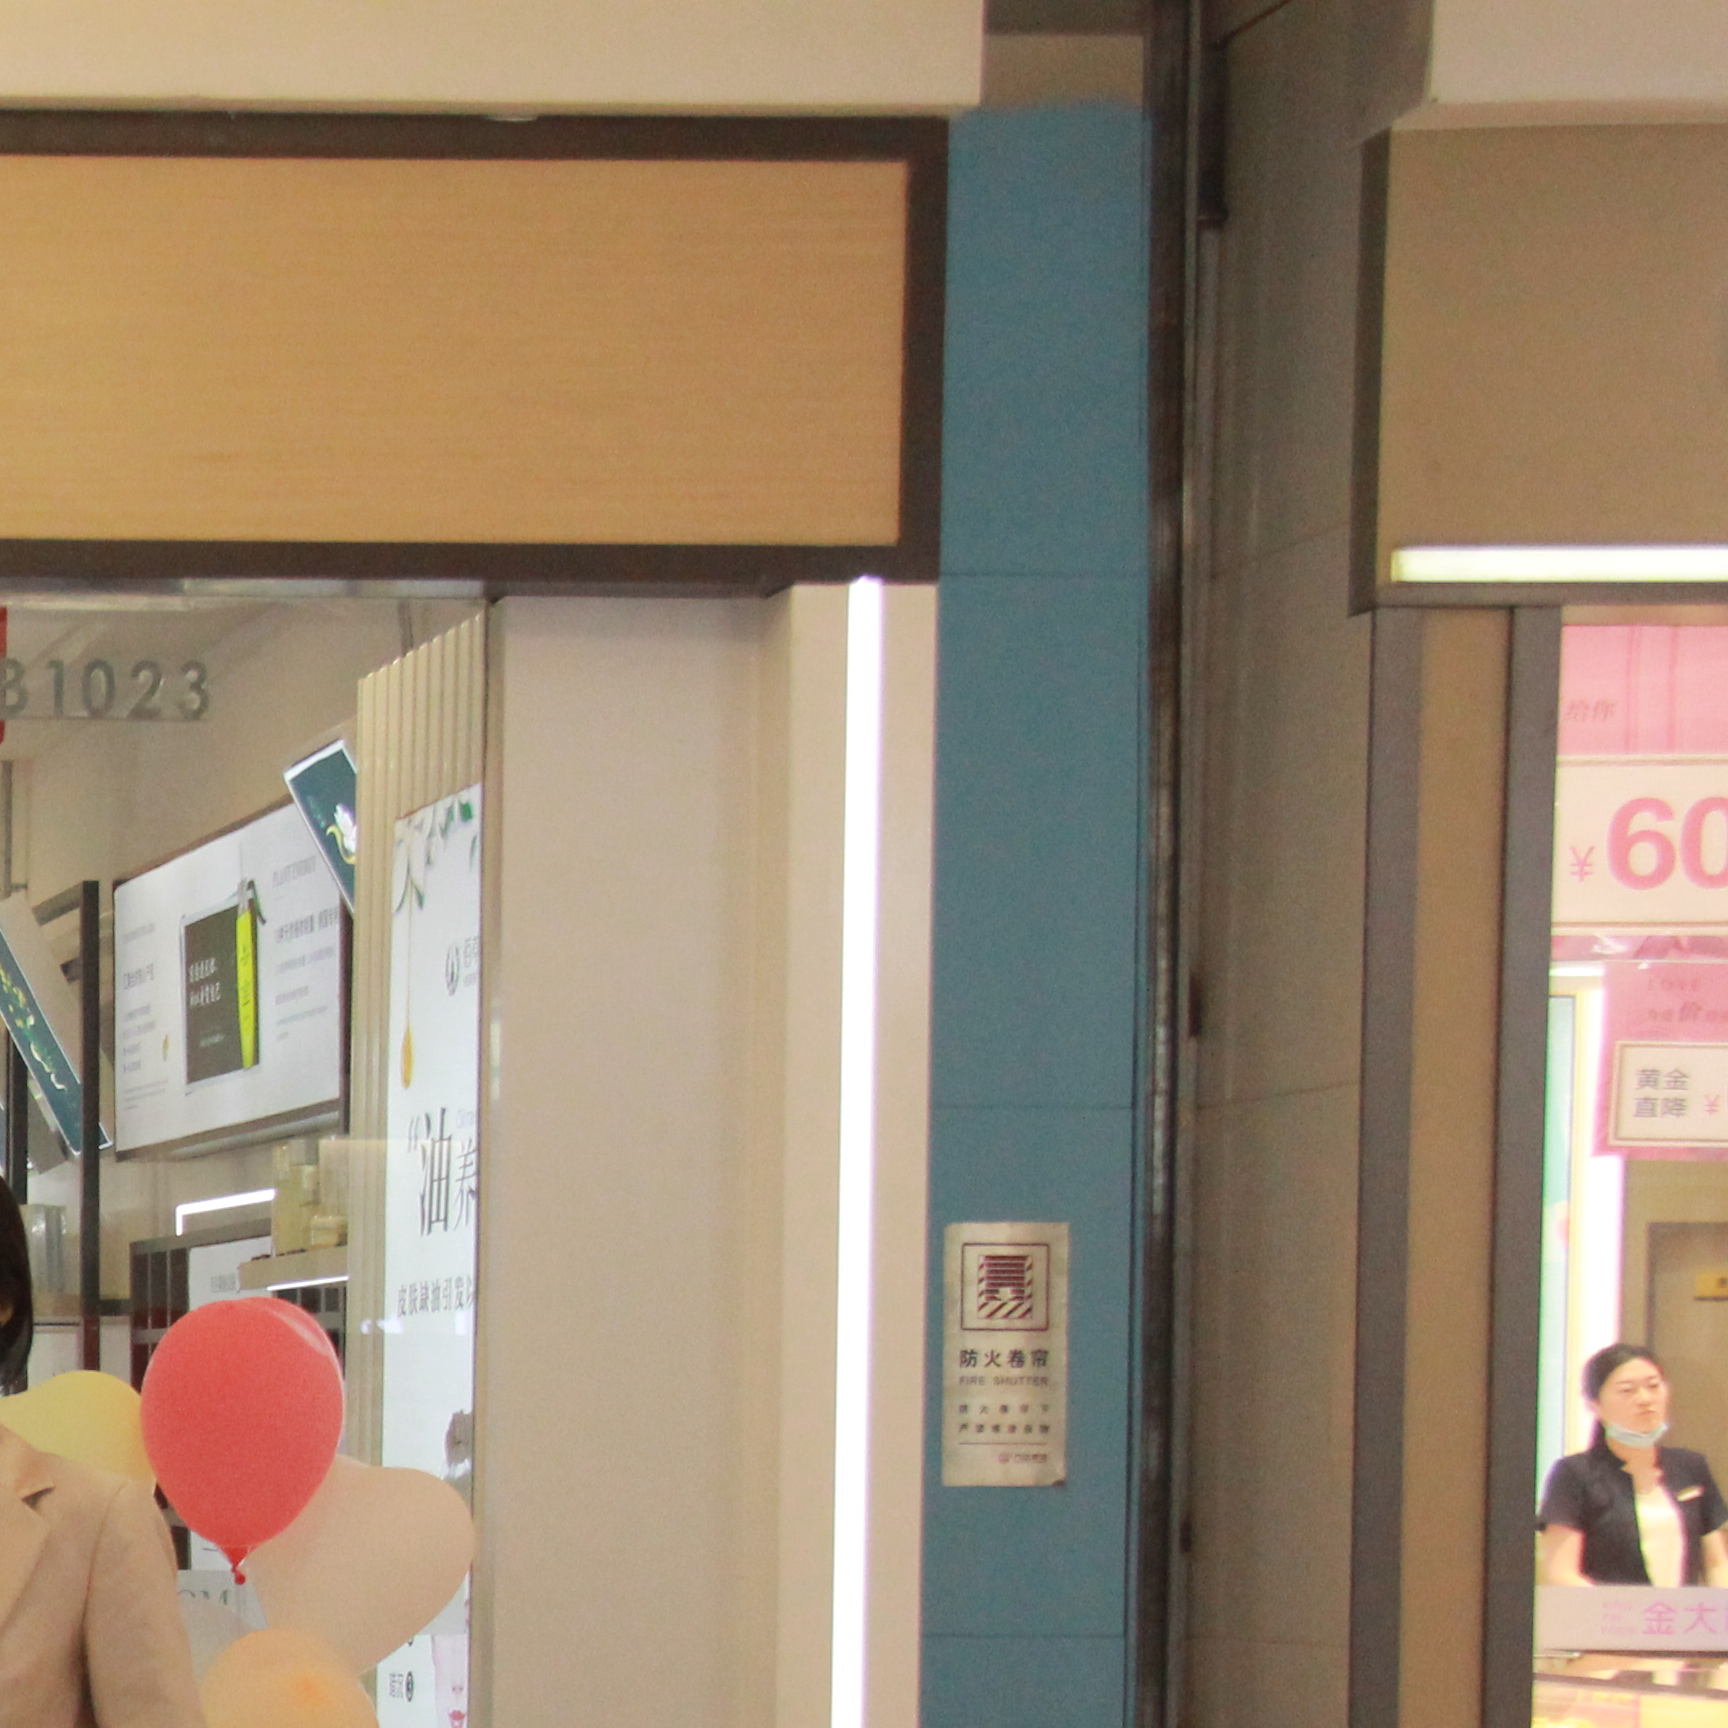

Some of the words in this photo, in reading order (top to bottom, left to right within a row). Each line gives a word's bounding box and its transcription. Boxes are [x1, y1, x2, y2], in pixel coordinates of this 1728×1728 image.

[959, 1349, 1050, 1369] 防火卷帘
[1643, 1600, 1728, 1635] 金大
